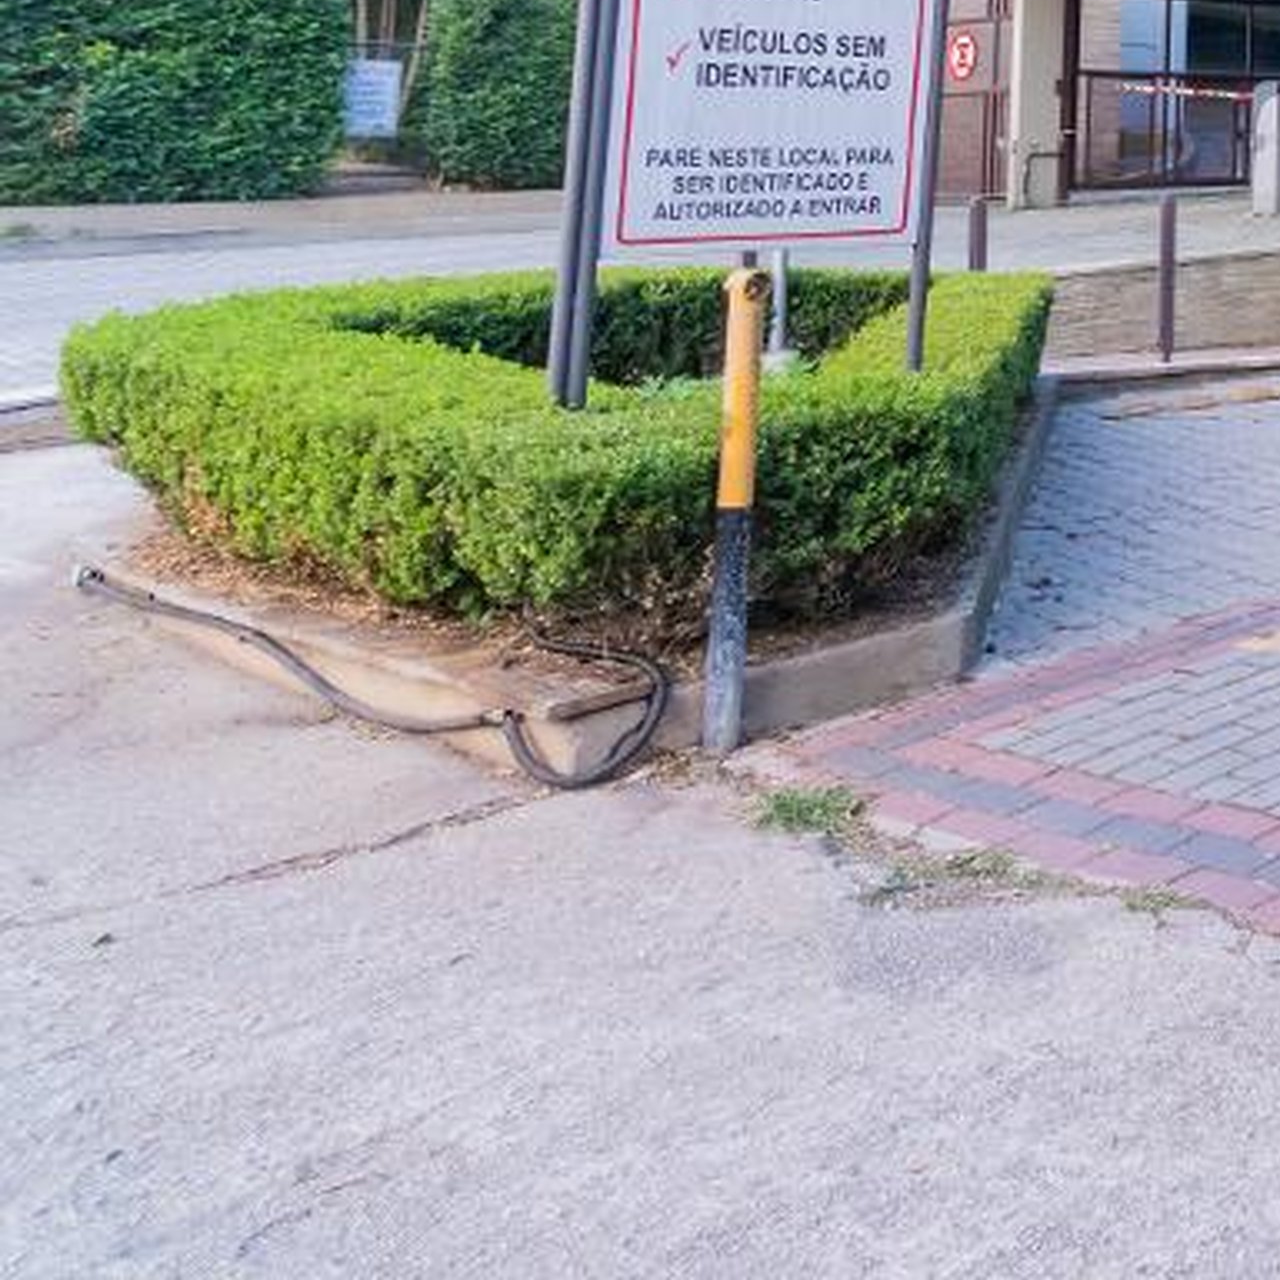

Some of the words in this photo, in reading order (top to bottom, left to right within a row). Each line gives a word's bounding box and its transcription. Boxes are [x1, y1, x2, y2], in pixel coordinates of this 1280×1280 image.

[700, 23, 828, 57] VEÍCULOS
[836, 35, 886, 59] SEM
[696, 62, 892, 92] IDENTIFICAÇÃO
[645, 148, 701, 168] PARE
[709, 148, 771, 168] NESTE
[779, 147, 839, 167] LOCAL
[846, 147, 895, 165] PARA
[672, 175, 715, 195] SER
[719, 173, 851, 194] IDENTIFICADO
[857, 172, 869, 191] E
[652, 199, 786, 221] AUTORIZADO
[788, 199, 803, 218] A
[809, 195, 882, 218] ENTRAR
